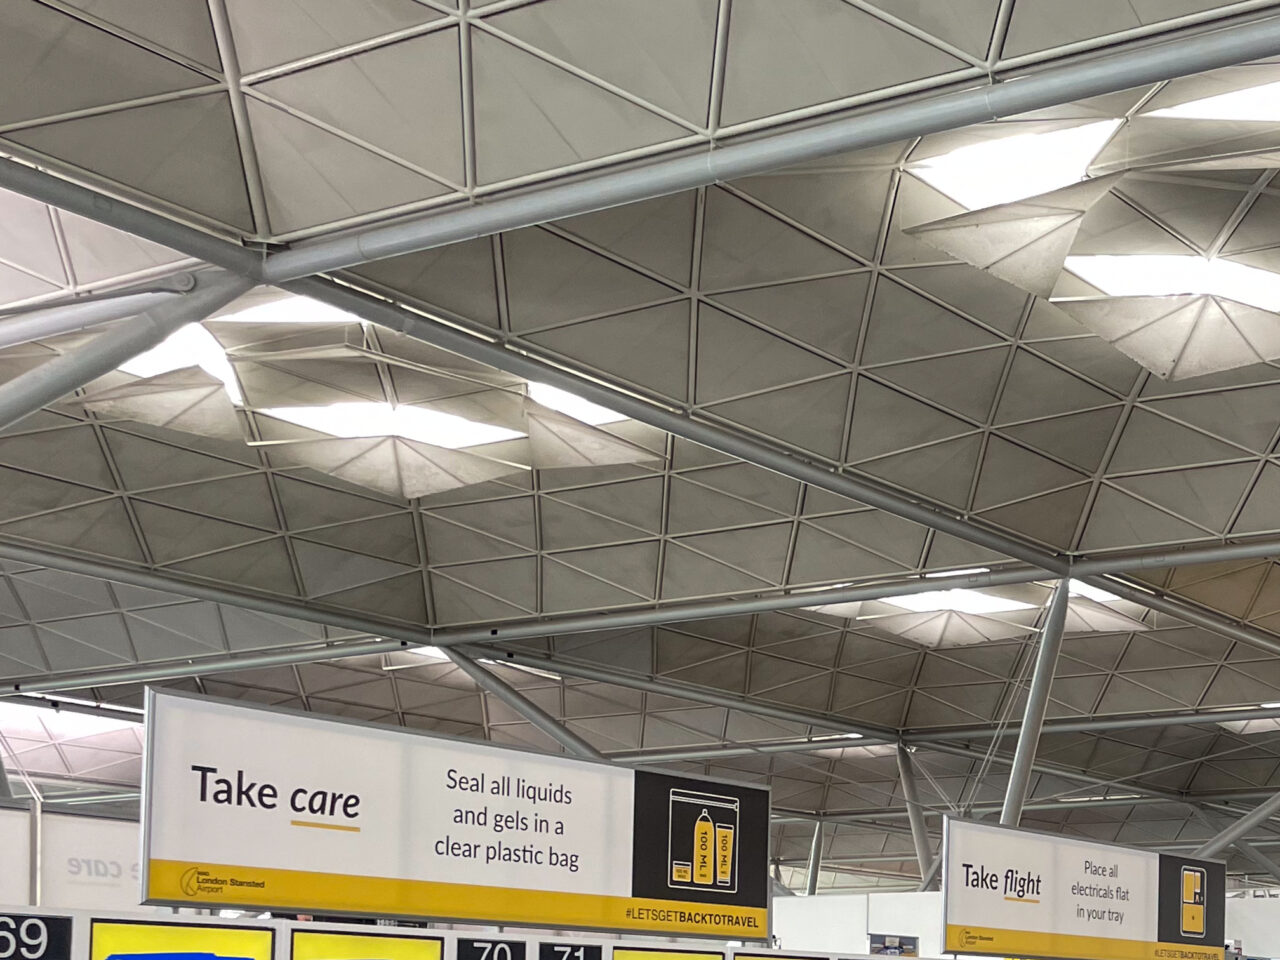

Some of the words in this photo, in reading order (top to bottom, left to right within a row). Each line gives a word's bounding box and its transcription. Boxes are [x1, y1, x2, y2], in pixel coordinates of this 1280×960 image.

[191, 764, 278, 810] Take
[290, 787, 361, 819] care
[446, 769, 485, 793] Seal
[490, 775, 511, 798] all
[516, 778, 573, 806] liquids
[453, 806, 487, 826] and
[494, 811, 528, 833] gels
[534, 816, 549, 834] in
[554, 819, 564, 835] a
[700, 831, 708, 851] 100
[434, 836, 481, 859] clear
[486, 841, 544, 865] plastic
[549, 850, 580, 873] bag
[1084, 860, 1107, 877] Place
[1109, 864, 1118, 878] all
[196, 876, 228, 886] London
[229, 878, 266, 889] Stansted
[962, 863, 999, 891] Take
[1003, 869, 1042, 899] flight
[1071, 883, 1114, 899] electricals
[1116, 886, 1130, 901] flat
[626, 907, 759, 929] #LETSGETBACKTOTRAVEL
[1076, 905, 1085, 918] in
[1086, 909, 1106, 922] your
[1108, 910, 1124, 924] tray
